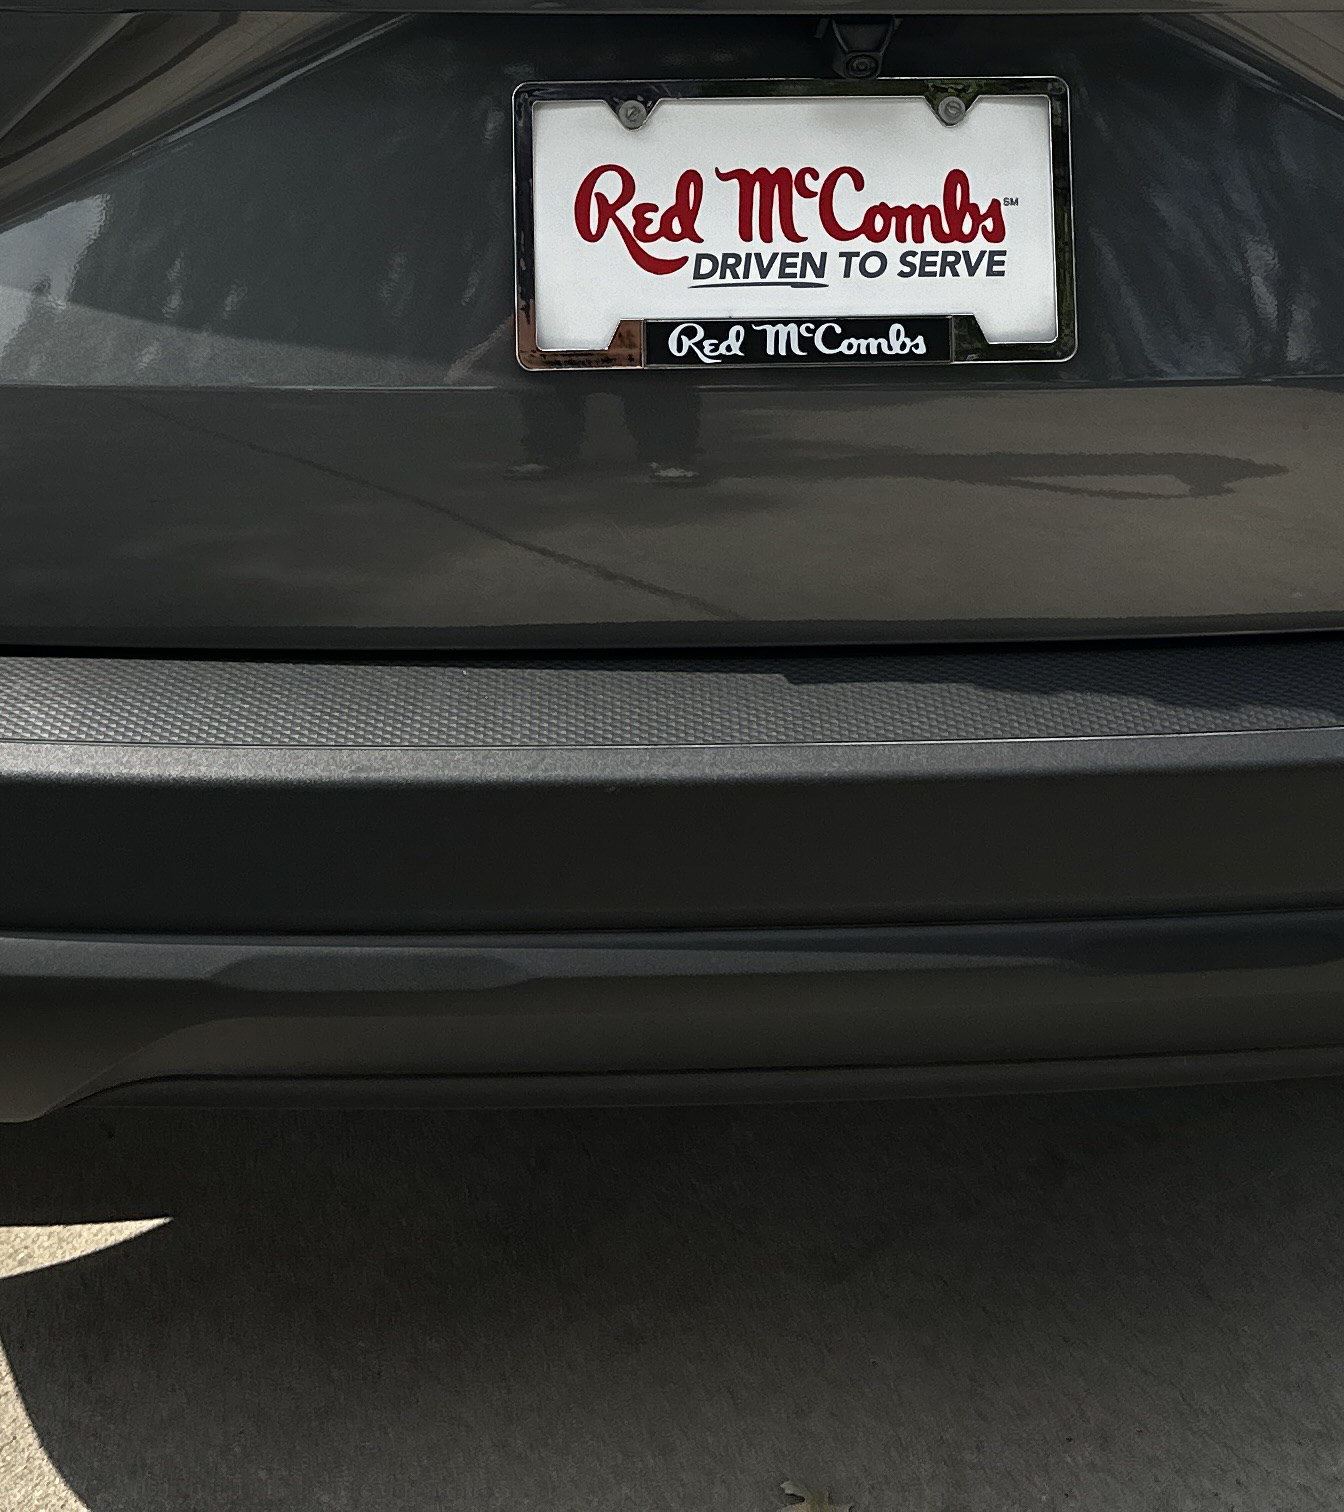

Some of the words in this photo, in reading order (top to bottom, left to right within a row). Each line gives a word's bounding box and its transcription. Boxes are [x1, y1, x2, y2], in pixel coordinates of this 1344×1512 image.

[573, 163, 705, 276] Red
[714, 165, 1007, 245] McCombs
[692, 250, 828, 281] DRIVEN
[840, 250, 888, 279] TO
[896, 249, 1008, 278] SERVE
[667, 322, 745, 364] Red
[751, 321, 927, 357] McCombs
